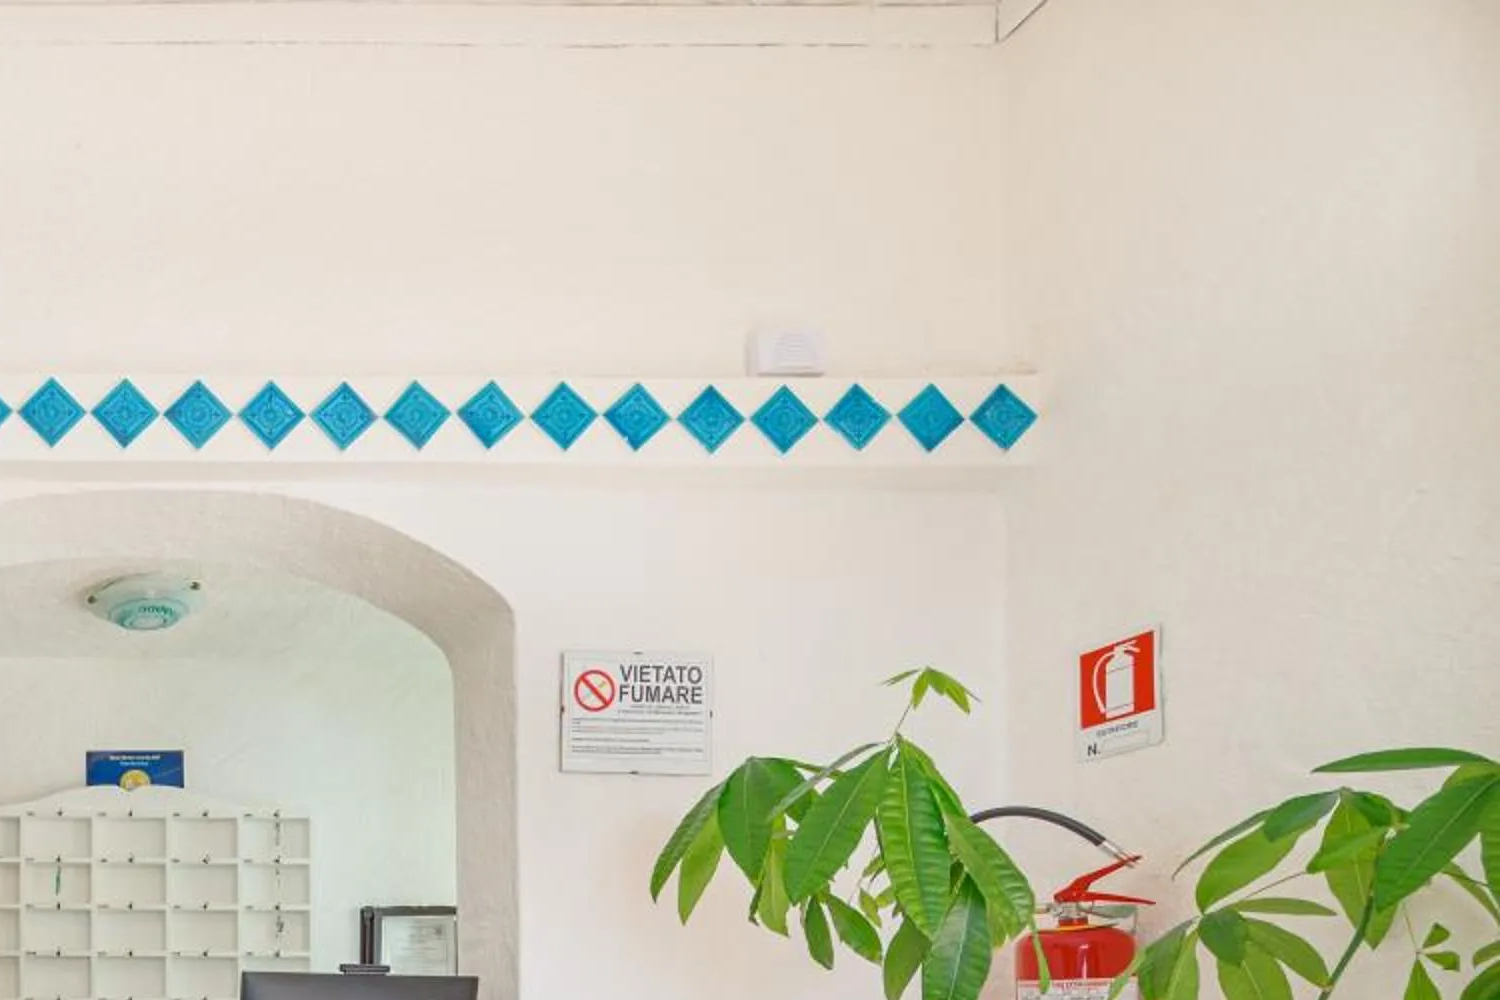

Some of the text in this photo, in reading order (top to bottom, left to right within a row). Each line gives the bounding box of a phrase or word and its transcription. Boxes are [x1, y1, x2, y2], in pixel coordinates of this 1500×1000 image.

[619, 664, 702, 684] VIETATO
[619, 685, 702, 704] FUMARE
[1087, 743, 1101, 757] N.
